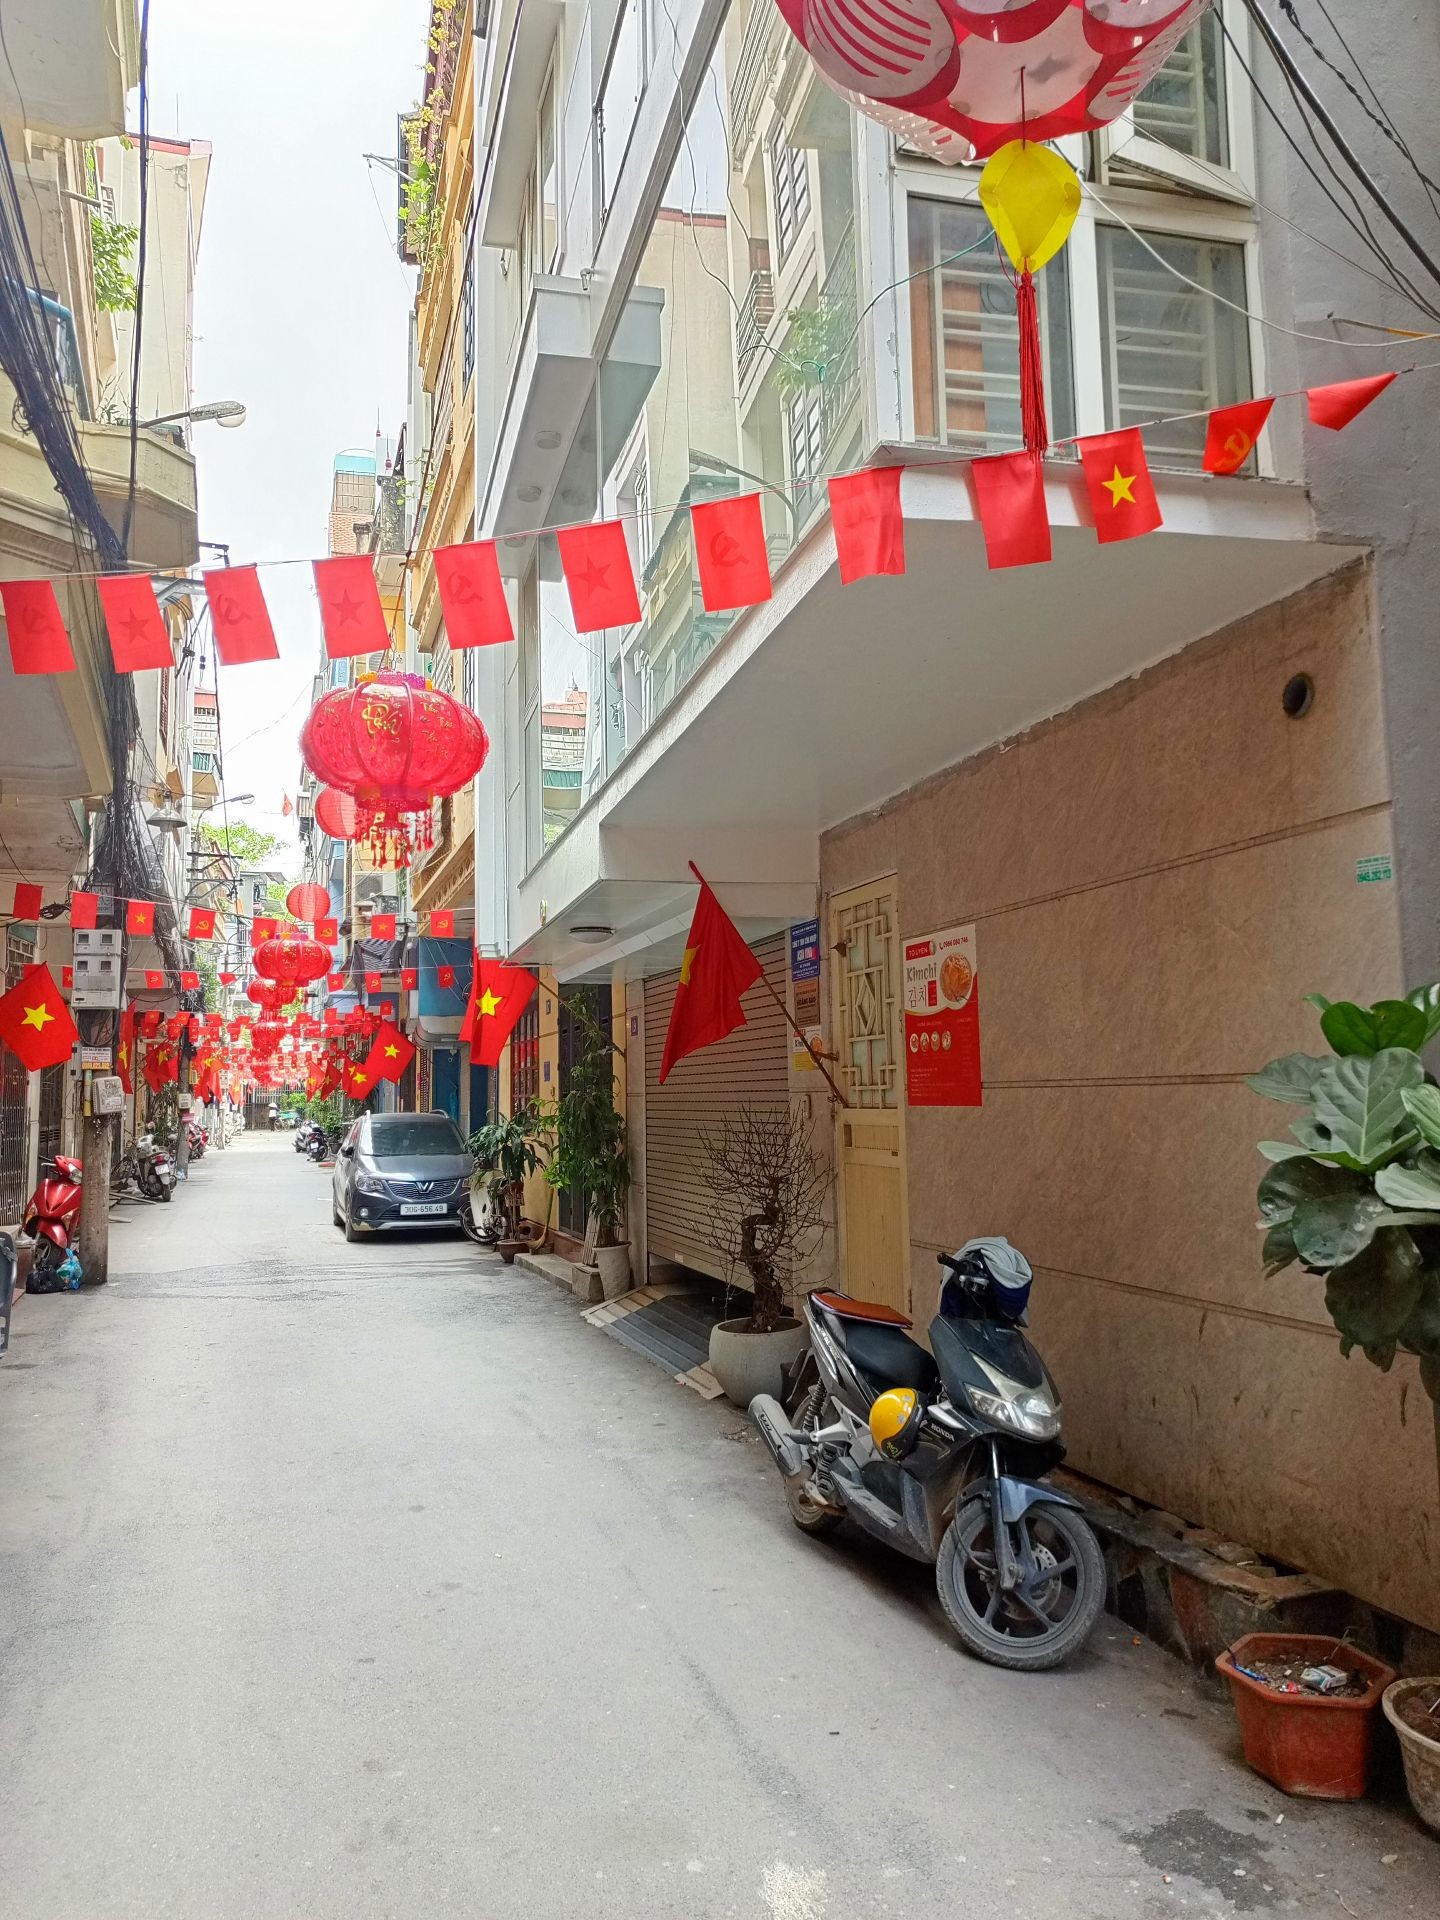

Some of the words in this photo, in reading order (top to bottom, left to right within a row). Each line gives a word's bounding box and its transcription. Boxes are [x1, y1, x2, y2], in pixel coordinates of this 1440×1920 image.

[906, 962, 937, 983] Kimchi
[908, 984, 927, 1008] 김치
[931, 1423, 955, 1442] HONDA
